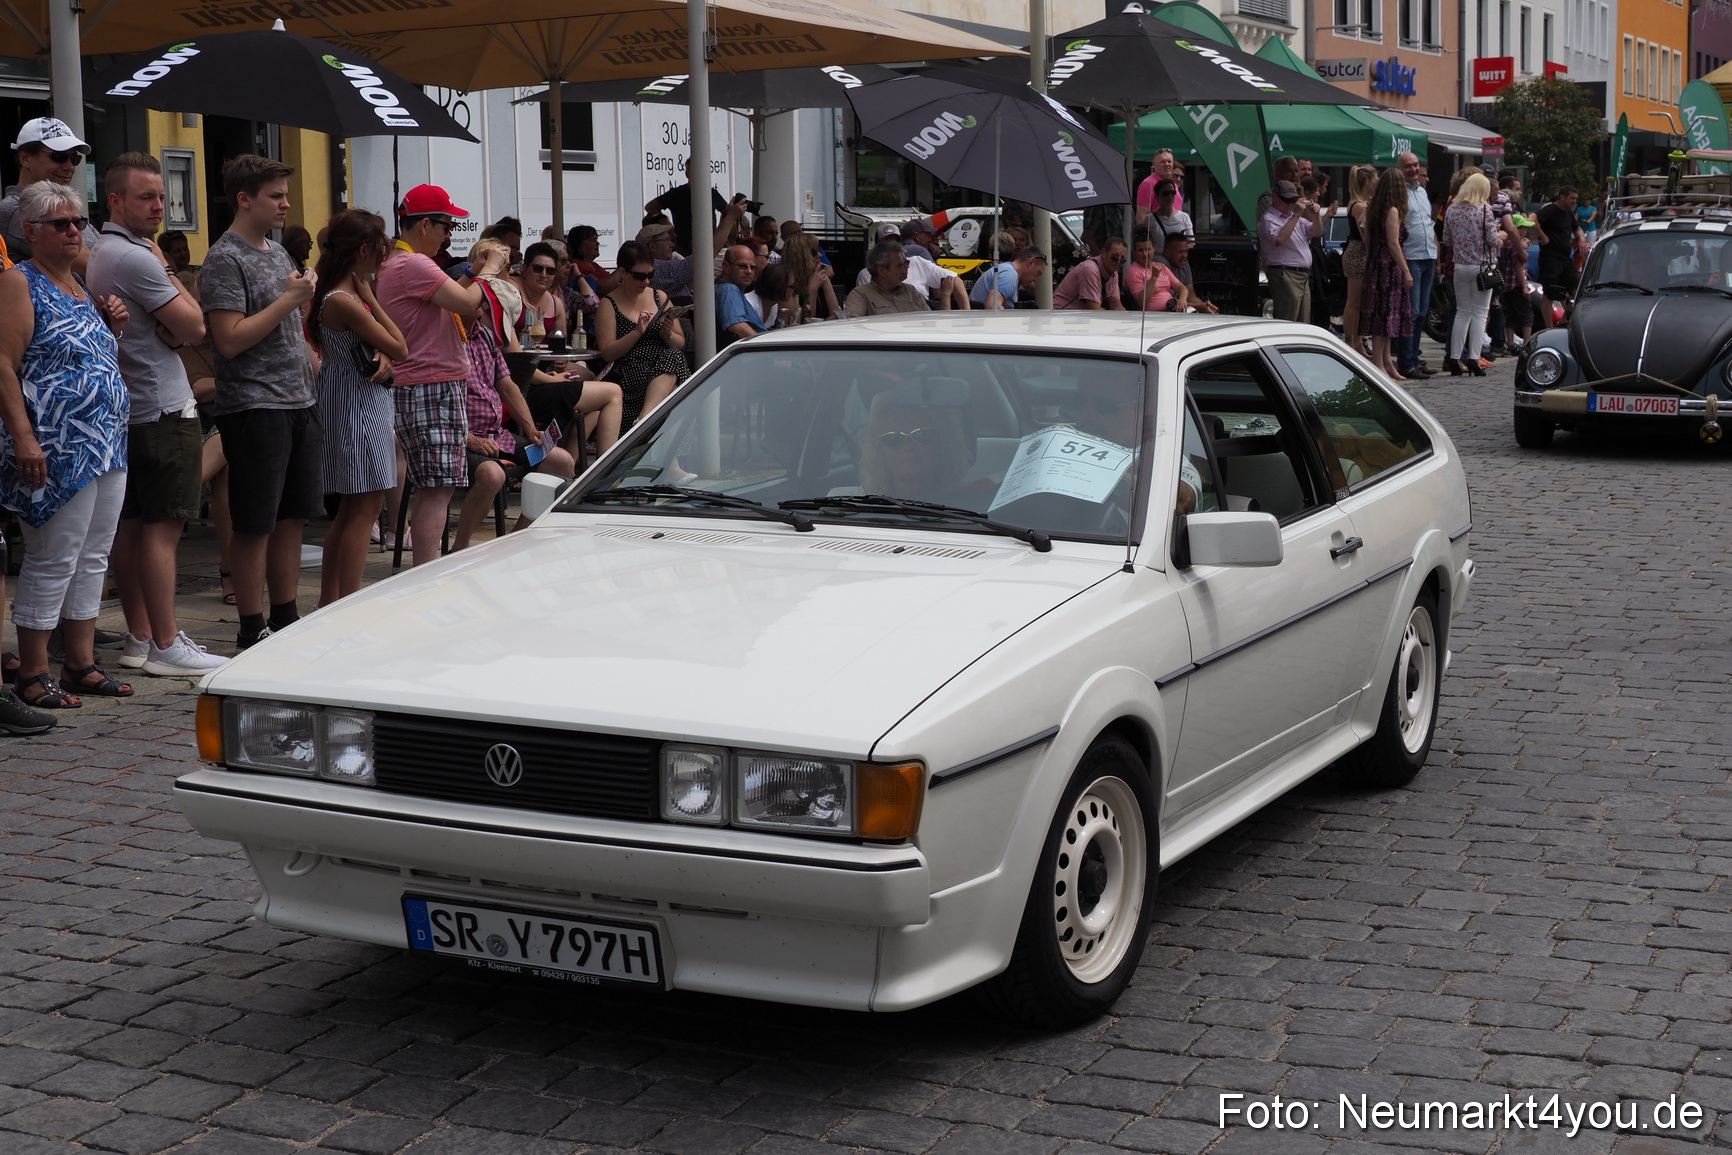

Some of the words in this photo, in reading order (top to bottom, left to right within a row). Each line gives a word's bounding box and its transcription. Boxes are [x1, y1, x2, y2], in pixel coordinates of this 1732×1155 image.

[105, 47, 201, 97] now
[1194, 45, 1279, 88] now
[1479, 70, 1507, 81] WITT
[341, 62, 420, 127] now
[662, 121, 679, 145] 30
[1683, 106, 1713, 151] EKRA
[646, 152, 674, 176] Bang
[677, 154, 685, 172] &
[451, 219, 478, 232] issler
[961, 231, 968, 239] 6
[1599, 396, 1625, 411] LAU
[1634, 398, 1677, 413] 07003
[1060, 440, 1110, 461] 574
[417, 929, 427, 941] D
[431, 909, 484, 953] SR
[508, 918, 532, 959] Y
[541, 922, 651, 977] 797H
[467, 958, 481, 968] Kfz
[487, 961, 522, 974] Kleehart
